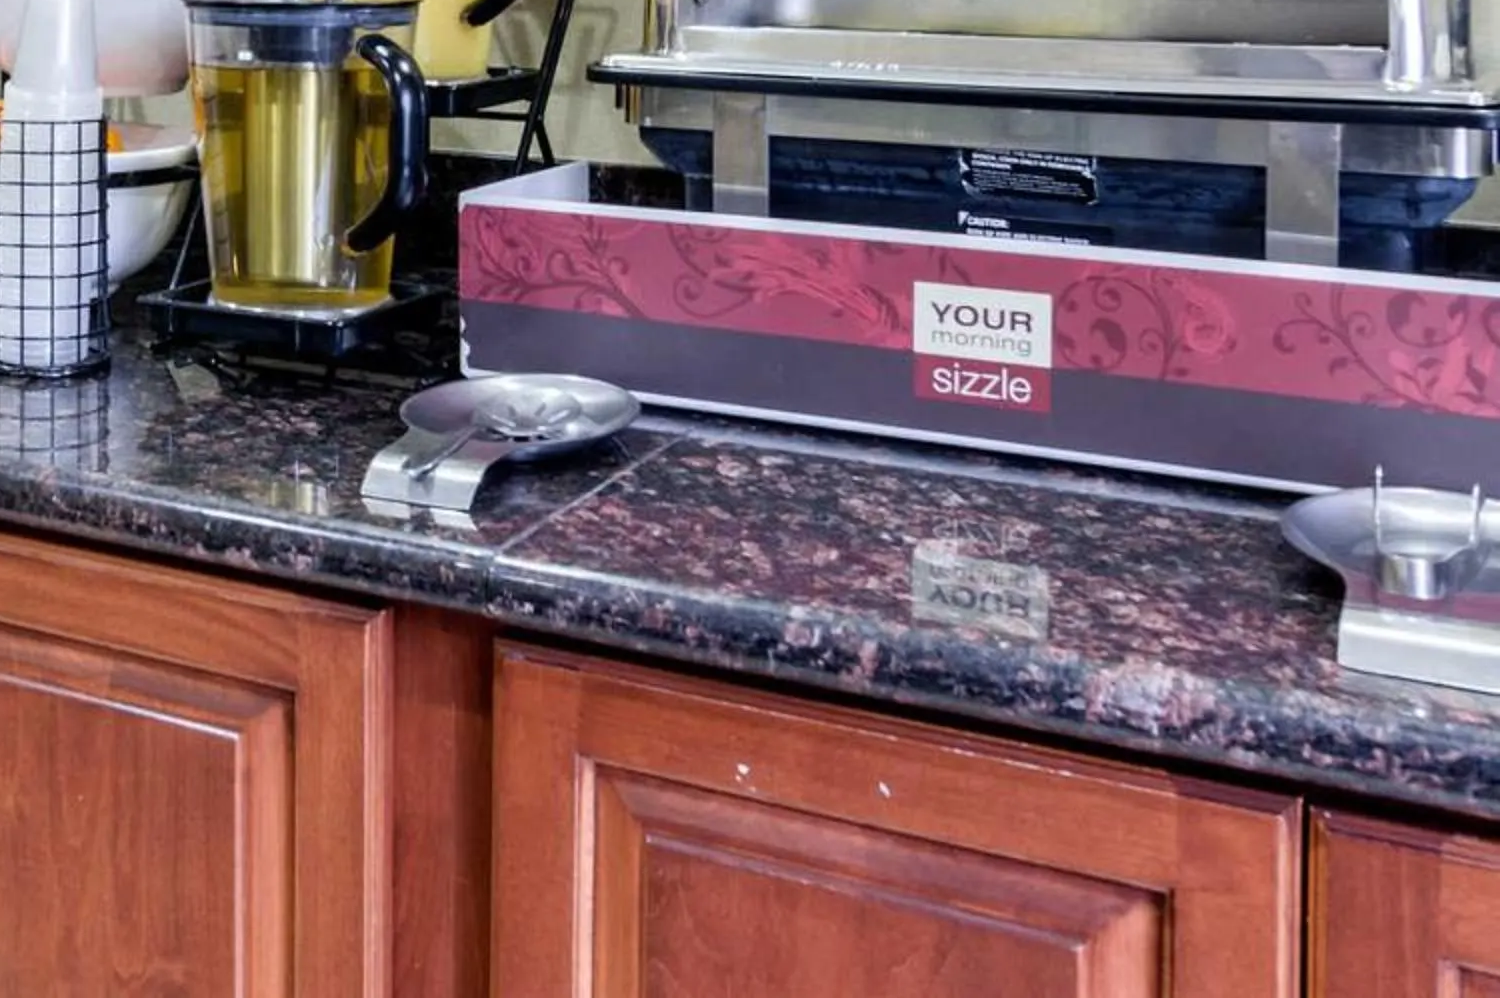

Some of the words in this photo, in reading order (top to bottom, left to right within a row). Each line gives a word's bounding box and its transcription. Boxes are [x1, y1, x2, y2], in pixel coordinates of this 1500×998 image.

[931, 301, 1033, 334] YOUR
[931, 329, 1033, 358] morning
[932, 362, 1033, 404] sizzle
